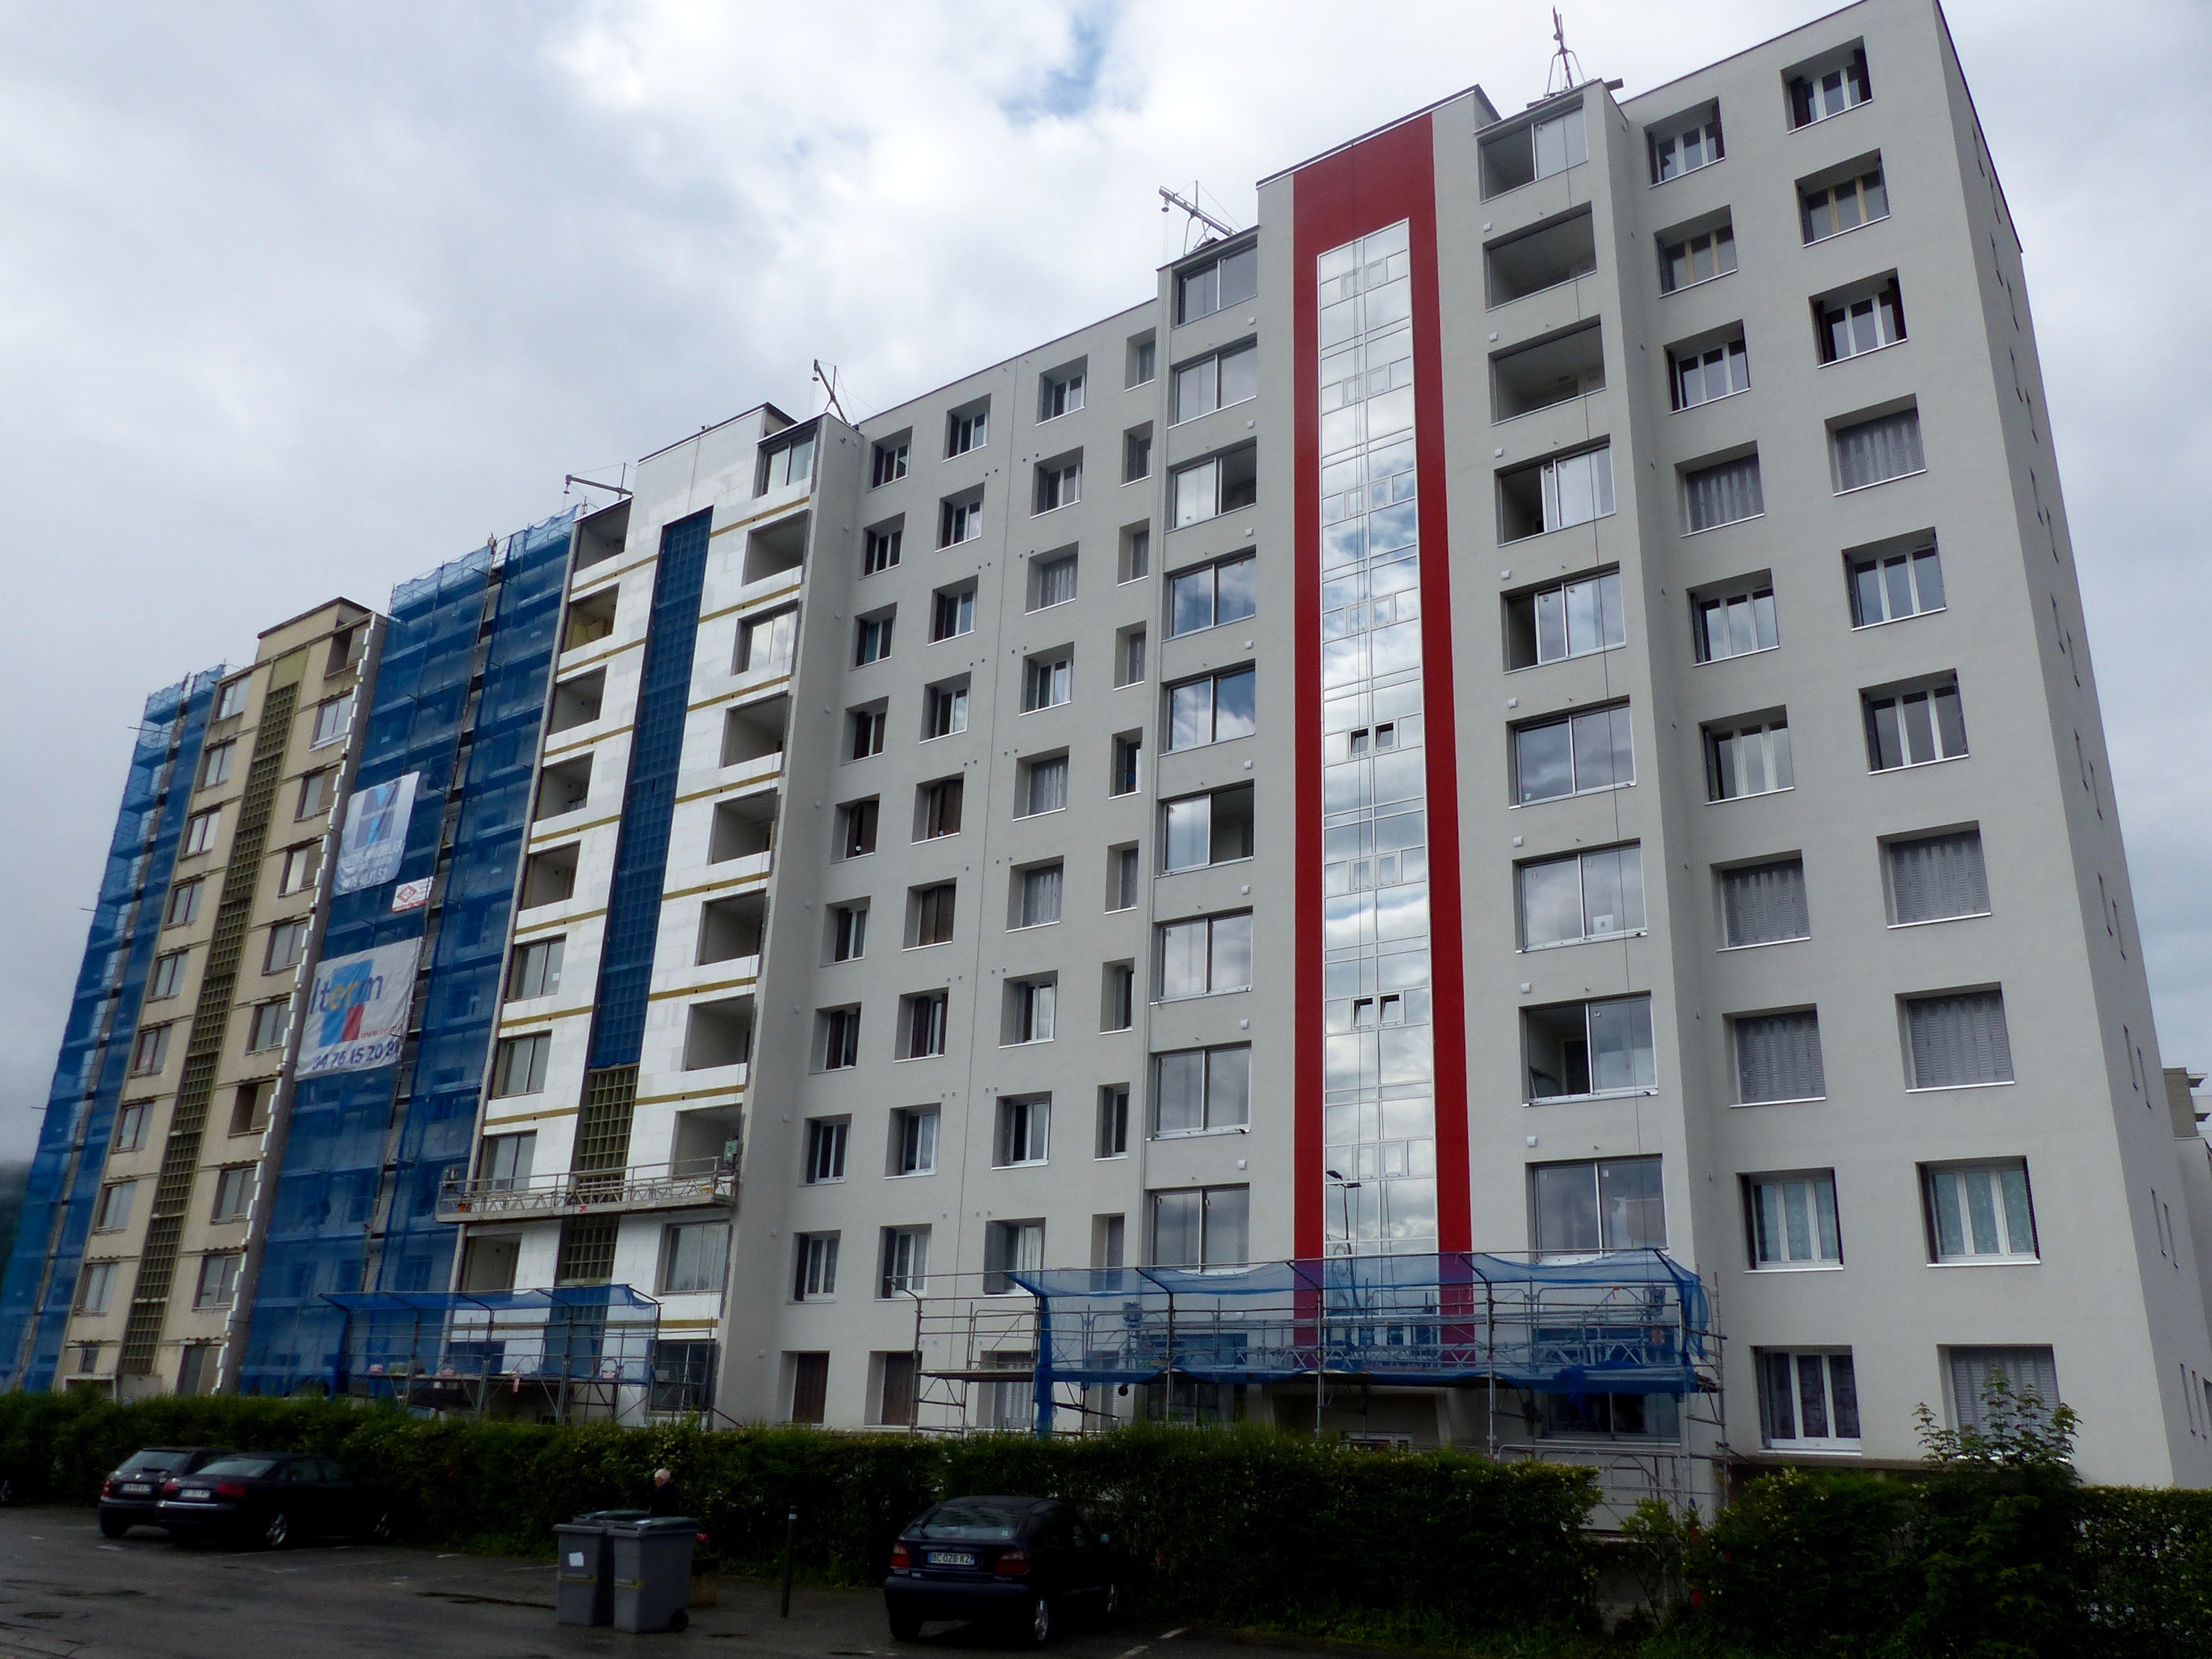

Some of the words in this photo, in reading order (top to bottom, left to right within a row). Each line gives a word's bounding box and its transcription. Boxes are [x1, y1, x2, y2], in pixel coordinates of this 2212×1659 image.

[331, 1051, 346, 1067] 76
[350, 1047, 364, 1064] 15
[366, 1044, 383, 1061] 20
